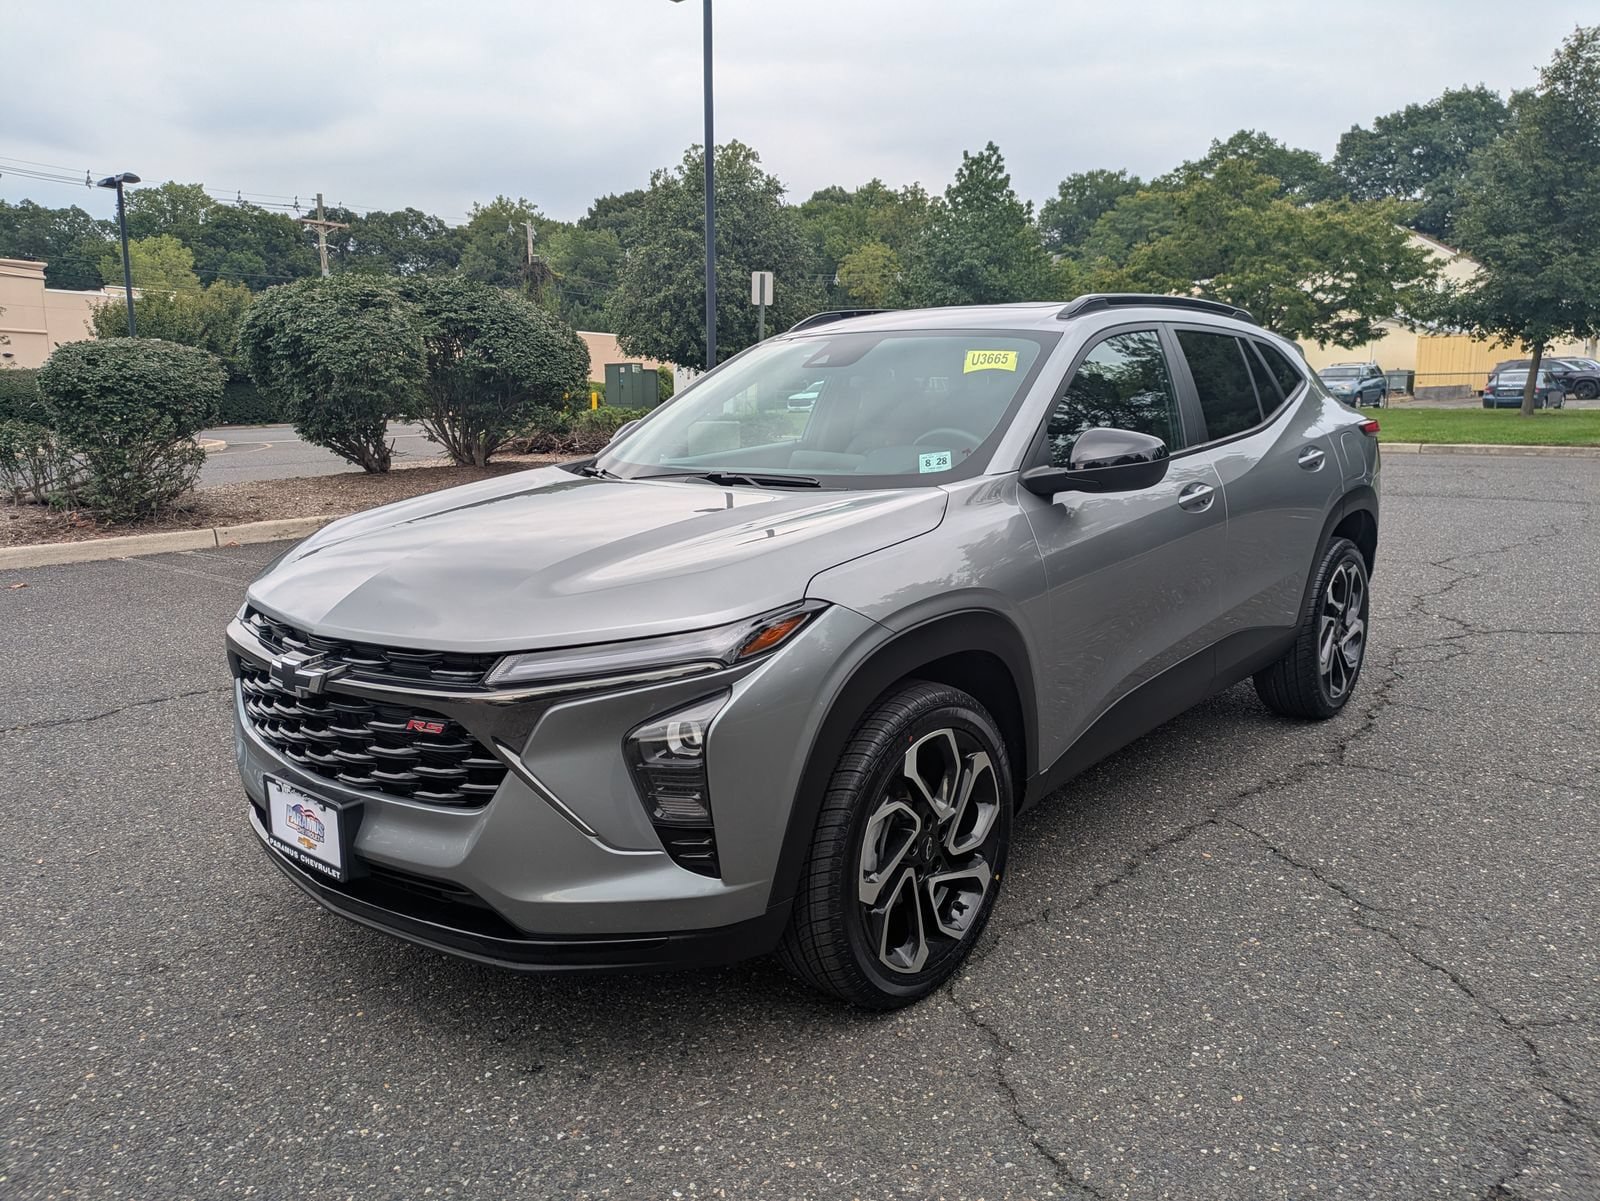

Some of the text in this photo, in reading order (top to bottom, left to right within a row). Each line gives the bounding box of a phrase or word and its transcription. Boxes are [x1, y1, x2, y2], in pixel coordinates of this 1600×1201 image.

[971, 353, 1009, 366] U3665
[925, 457, 947, 467] 8 28
[406, 720, 444, 733] RS
[269, 837, 341, 880] PARAMUS CHEVROLET
